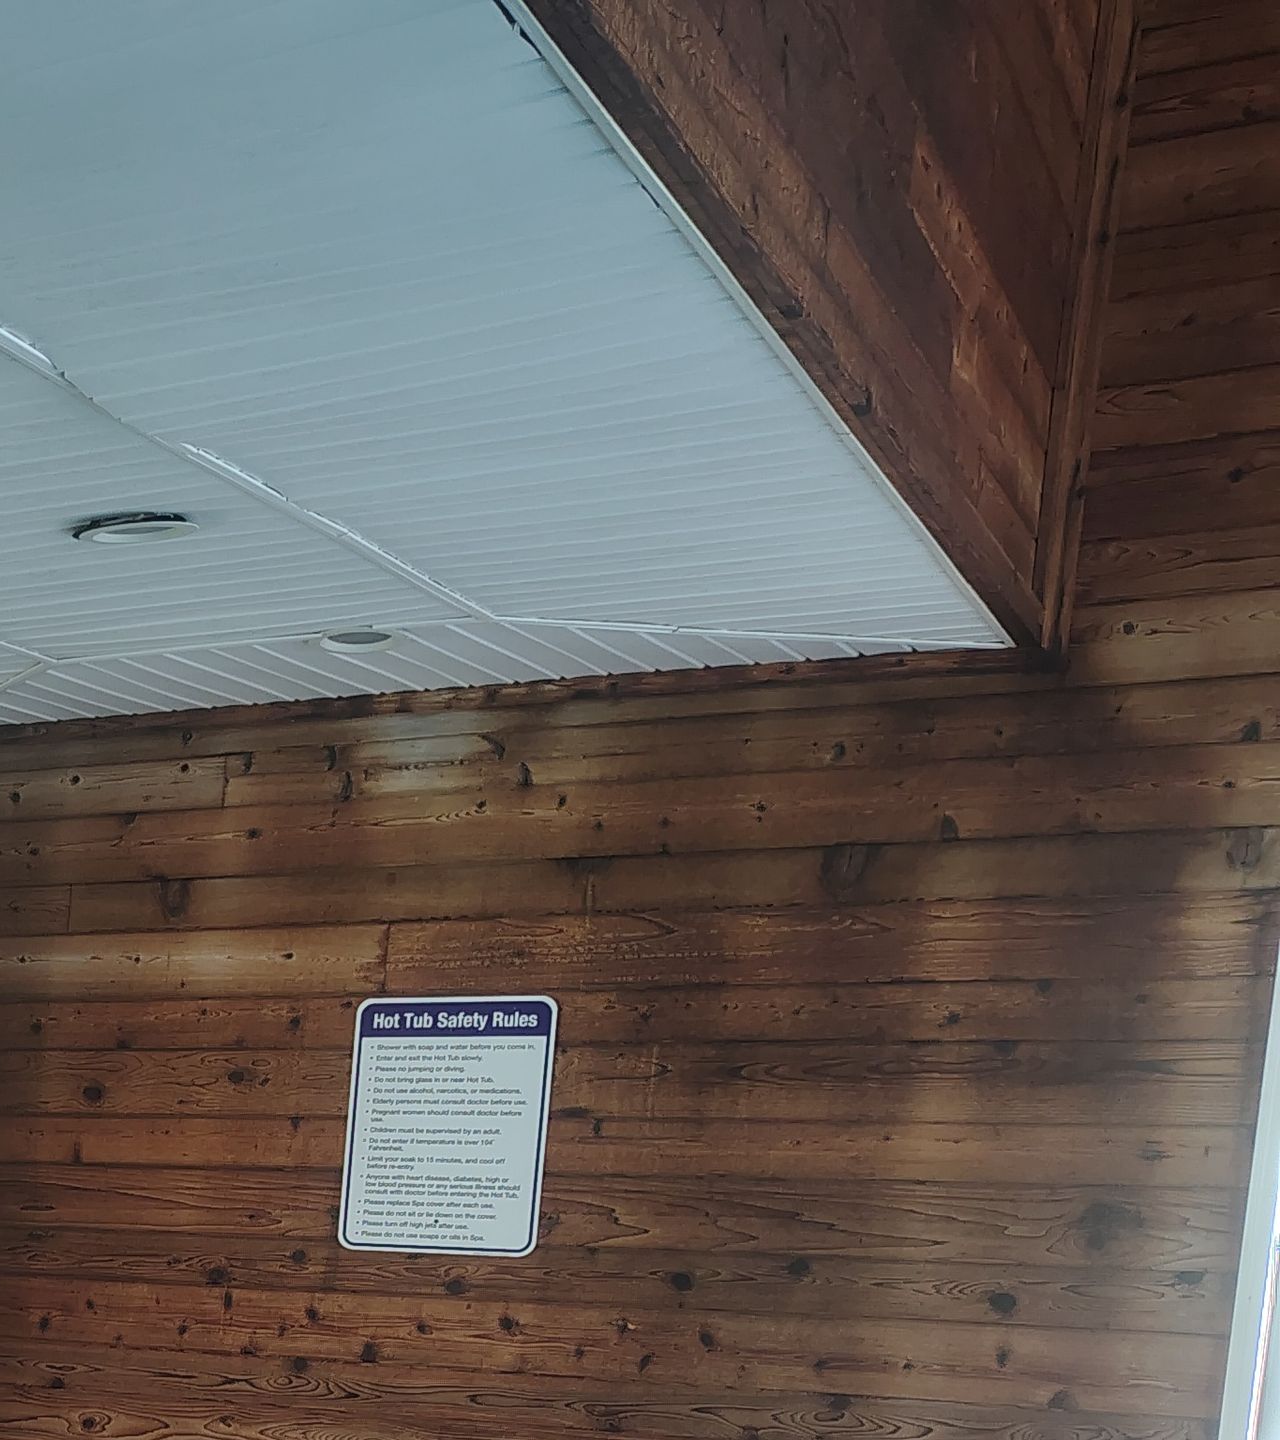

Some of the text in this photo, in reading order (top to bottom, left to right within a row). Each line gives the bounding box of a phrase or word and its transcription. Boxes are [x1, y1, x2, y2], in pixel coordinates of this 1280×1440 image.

[373, 1011, 538, 1031] Hot Tub Safety Rules
[451, 1191, 477, 1199] entering
